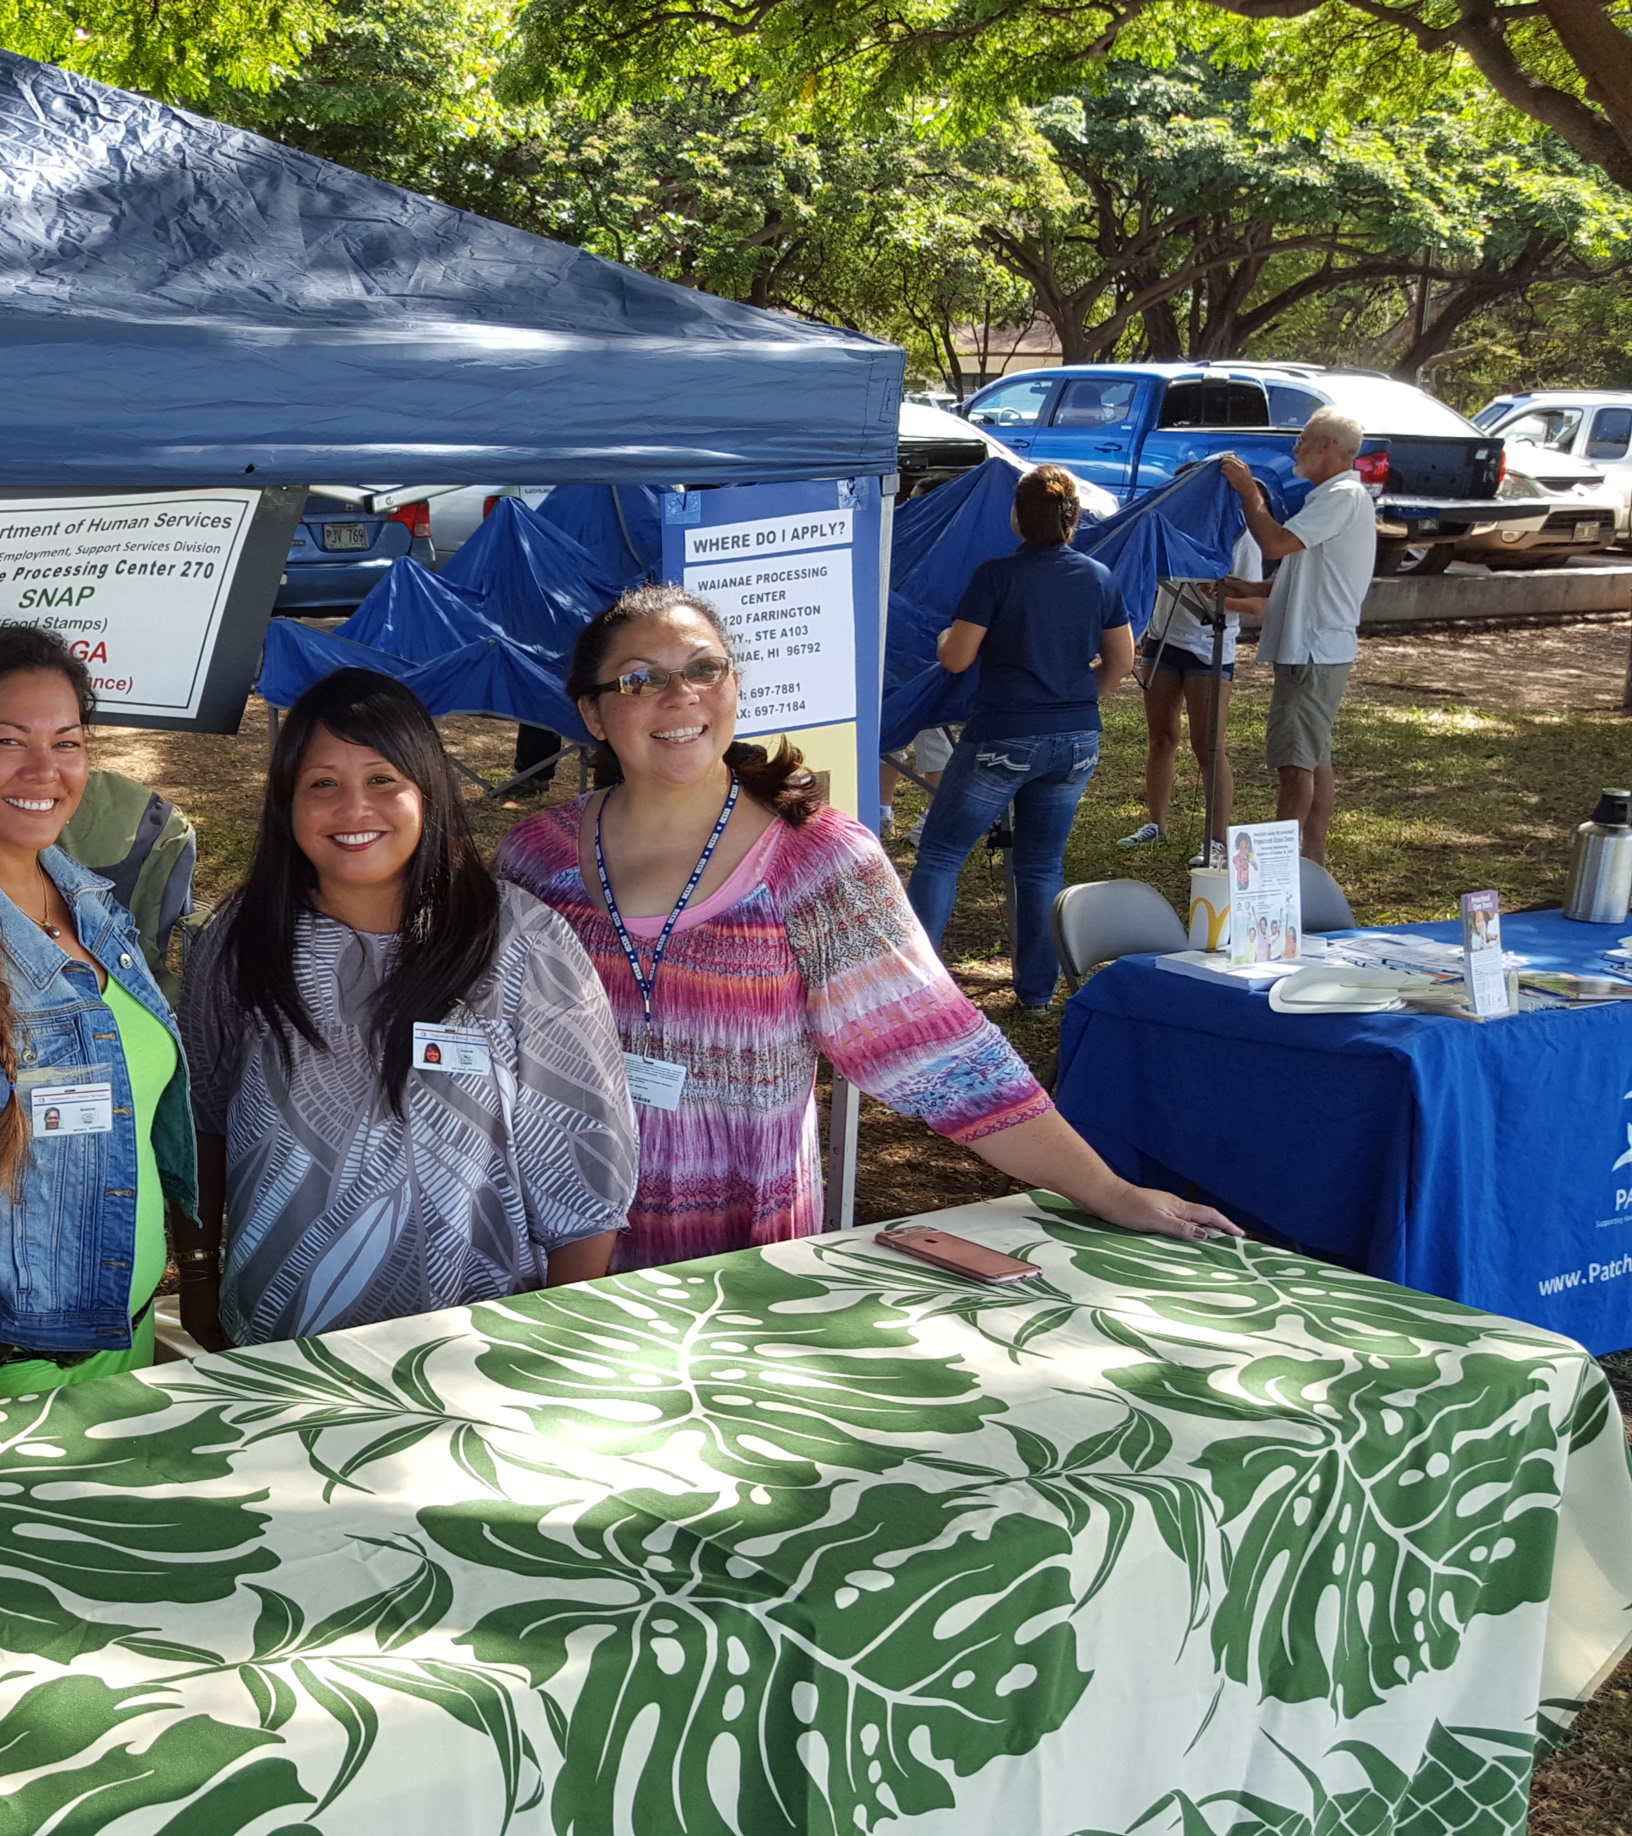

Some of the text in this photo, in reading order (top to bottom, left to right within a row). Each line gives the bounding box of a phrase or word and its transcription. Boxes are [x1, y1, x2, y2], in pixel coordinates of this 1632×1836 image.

[64, 519, 86, 534] of
[87, 516, 149, 533] Human
[154, 512, 232, 529] Services
[348, 530, 364, 542] 769
[693, 522, 846, 554] WHERE DO I APPLY?
[75, 542, 121, 556] Support
[123, 540, 170, 552] Services
[173, 540, 220, 554] Division
[12, 560, 109, 582] Processing
[115, 560, 176, 577] Center
[180, 561, 214, 579] 270
[698, 566, 828, 591] WAIANAE PROCESSING
[18, 586, 94, 609] SNAP
[741, 590, 786, 605] CENTER
[723, 605, 821, 626] 120 FARRINGTON
[42, 616, 108, 633] Stamps)
[755, 629, 776, 642] STE
[780, 625, 808, 638] A103
[768, 648, 779, 658] HI
[787, 642, 821, 656] 96792
[750, 682, 801, 698] 697-7881
[754, 700, 805, 716] 697-7184
[1614, 1188, 1632, 1212] PA
